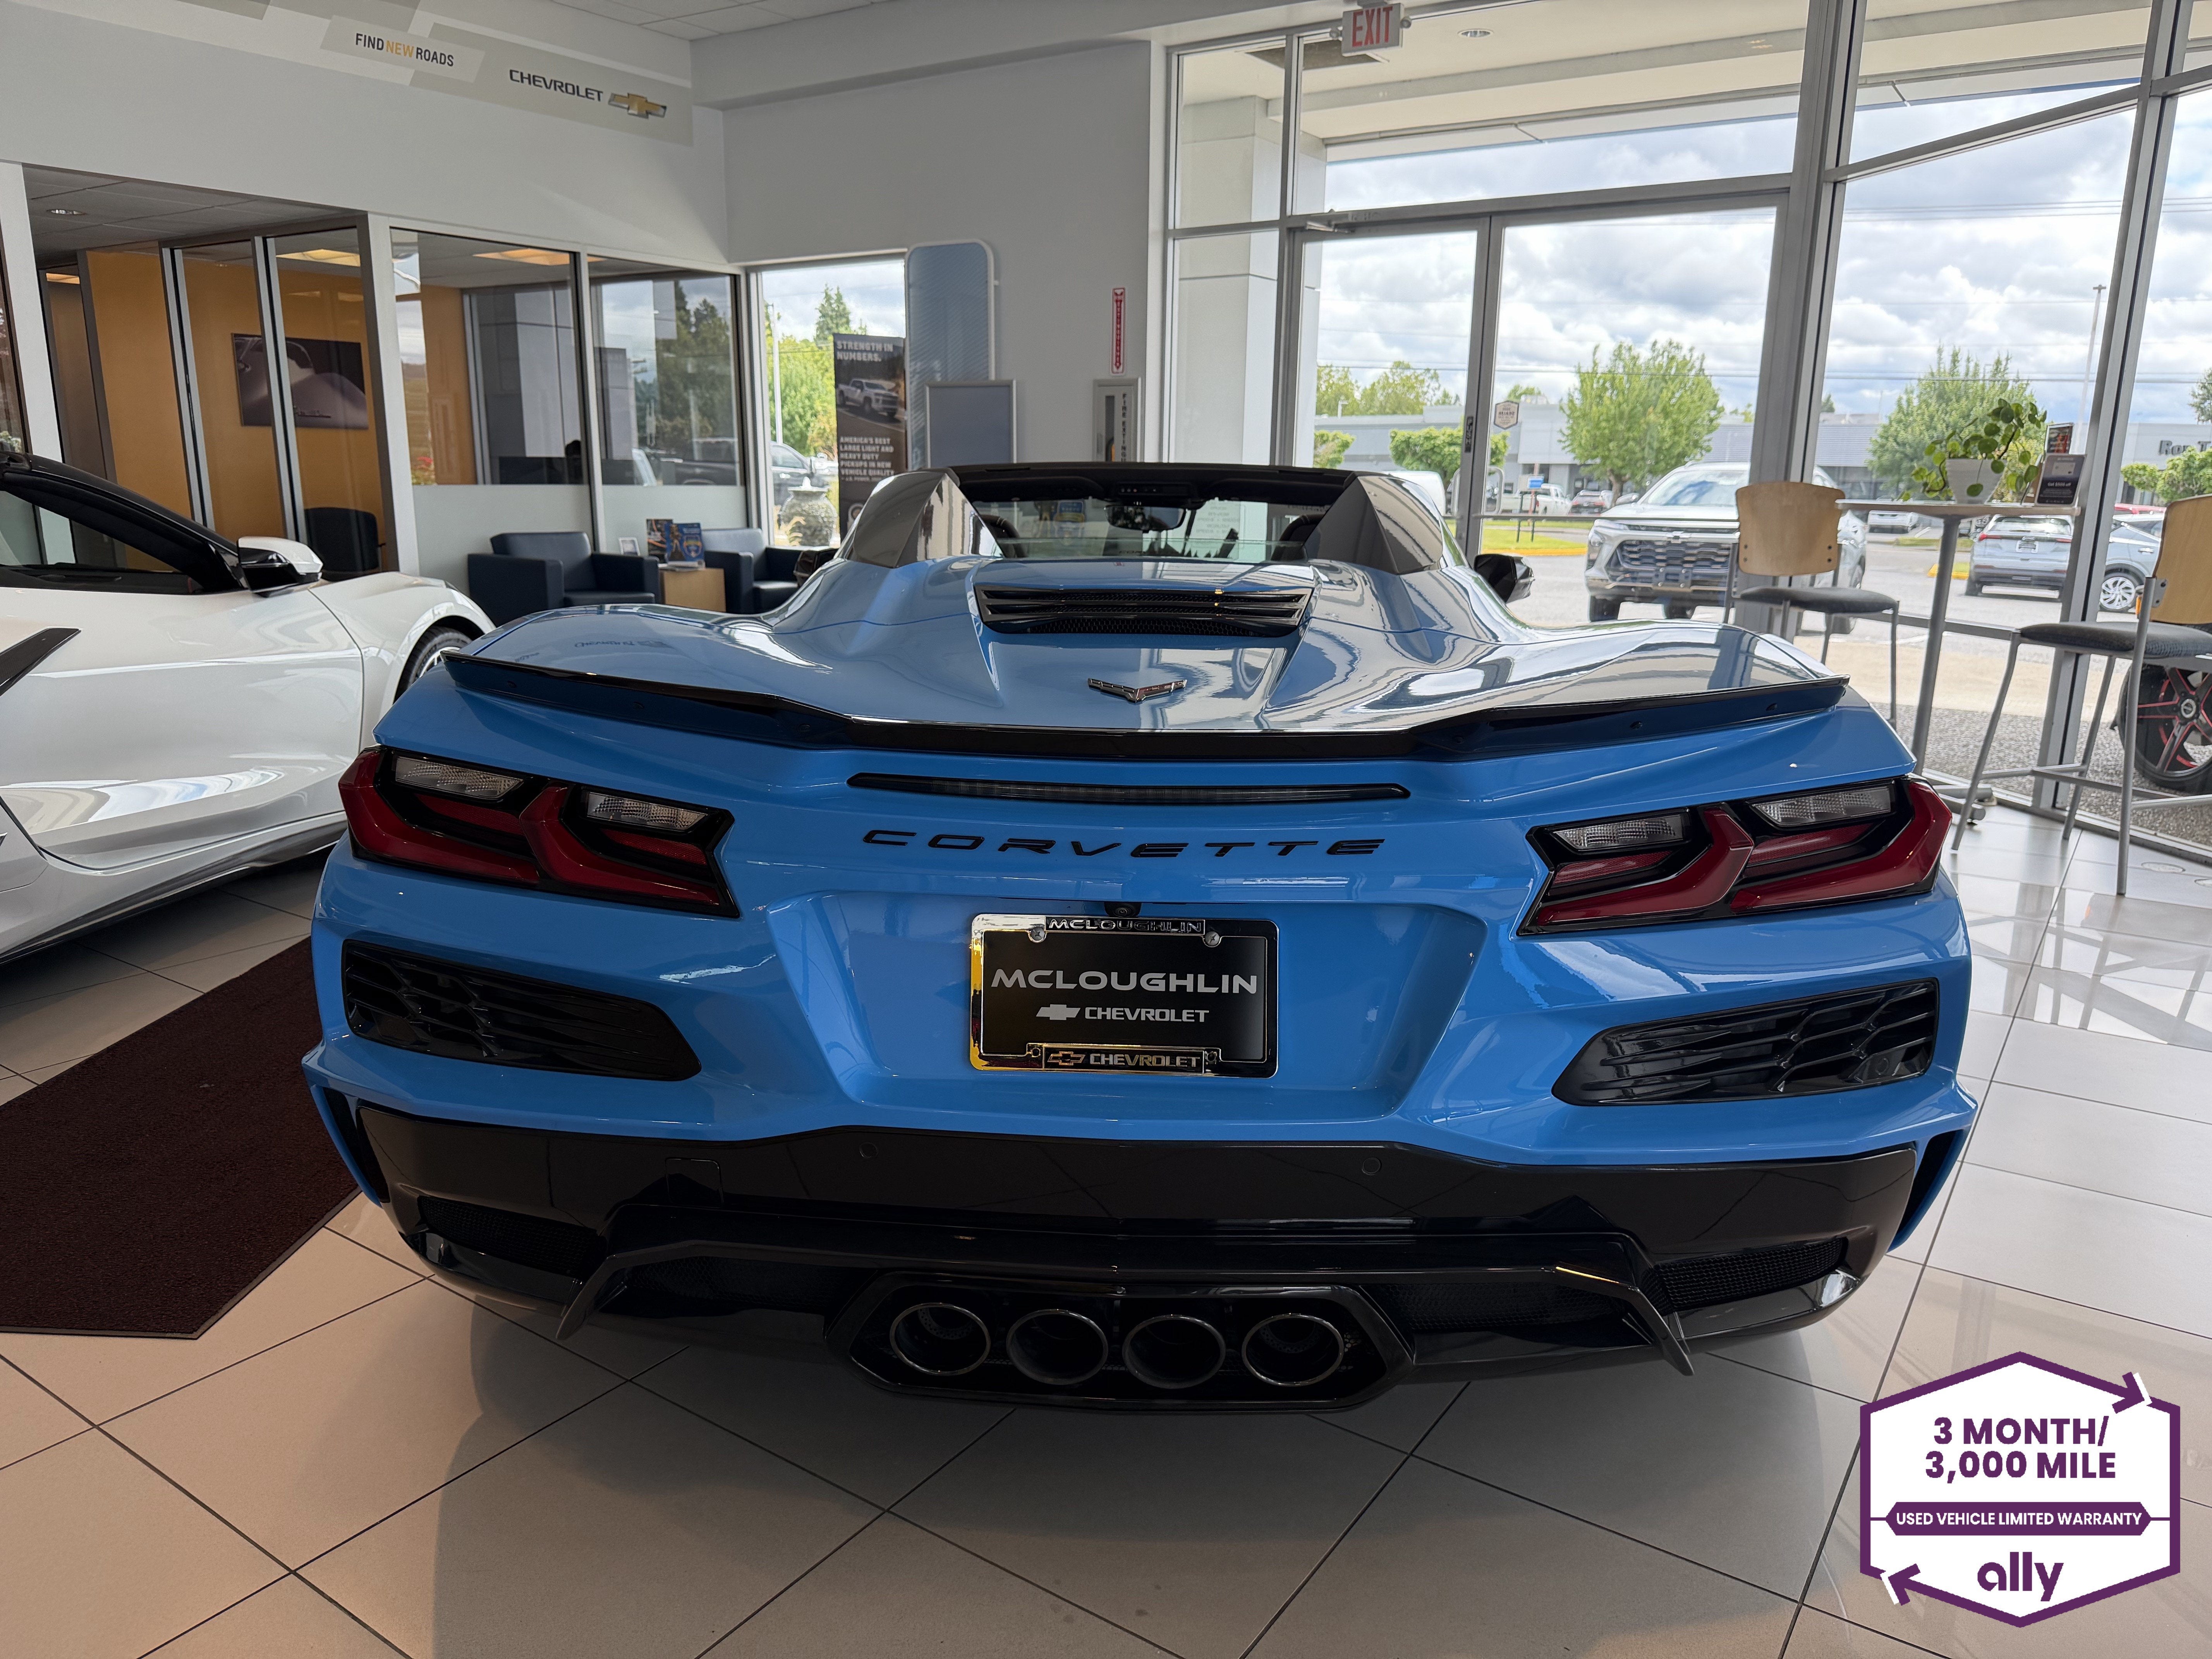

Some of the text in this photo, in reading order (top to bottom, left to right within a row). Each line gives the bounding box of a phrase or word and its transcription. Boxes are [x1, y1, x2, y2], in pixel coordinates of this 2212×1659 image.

[1352, 7, 1393, 47] EXIT
[356, 33, 454, 67] FIND NEW ROADS
[510, 69, 603, 101] CHEVROLET
[837, 341, 893, 352] STRENGTH IN
[863, 830, 1386, 858] CORVETTE
[1049, 919, 1201, 933] MCLOUGHLIN
[991, 969, 1257, 994] MCLOUGHLIN
[1085, 1007, 1209, 1022] CHEVROLET
[1090, 1053, 1200, 1067] CHEVROLET
